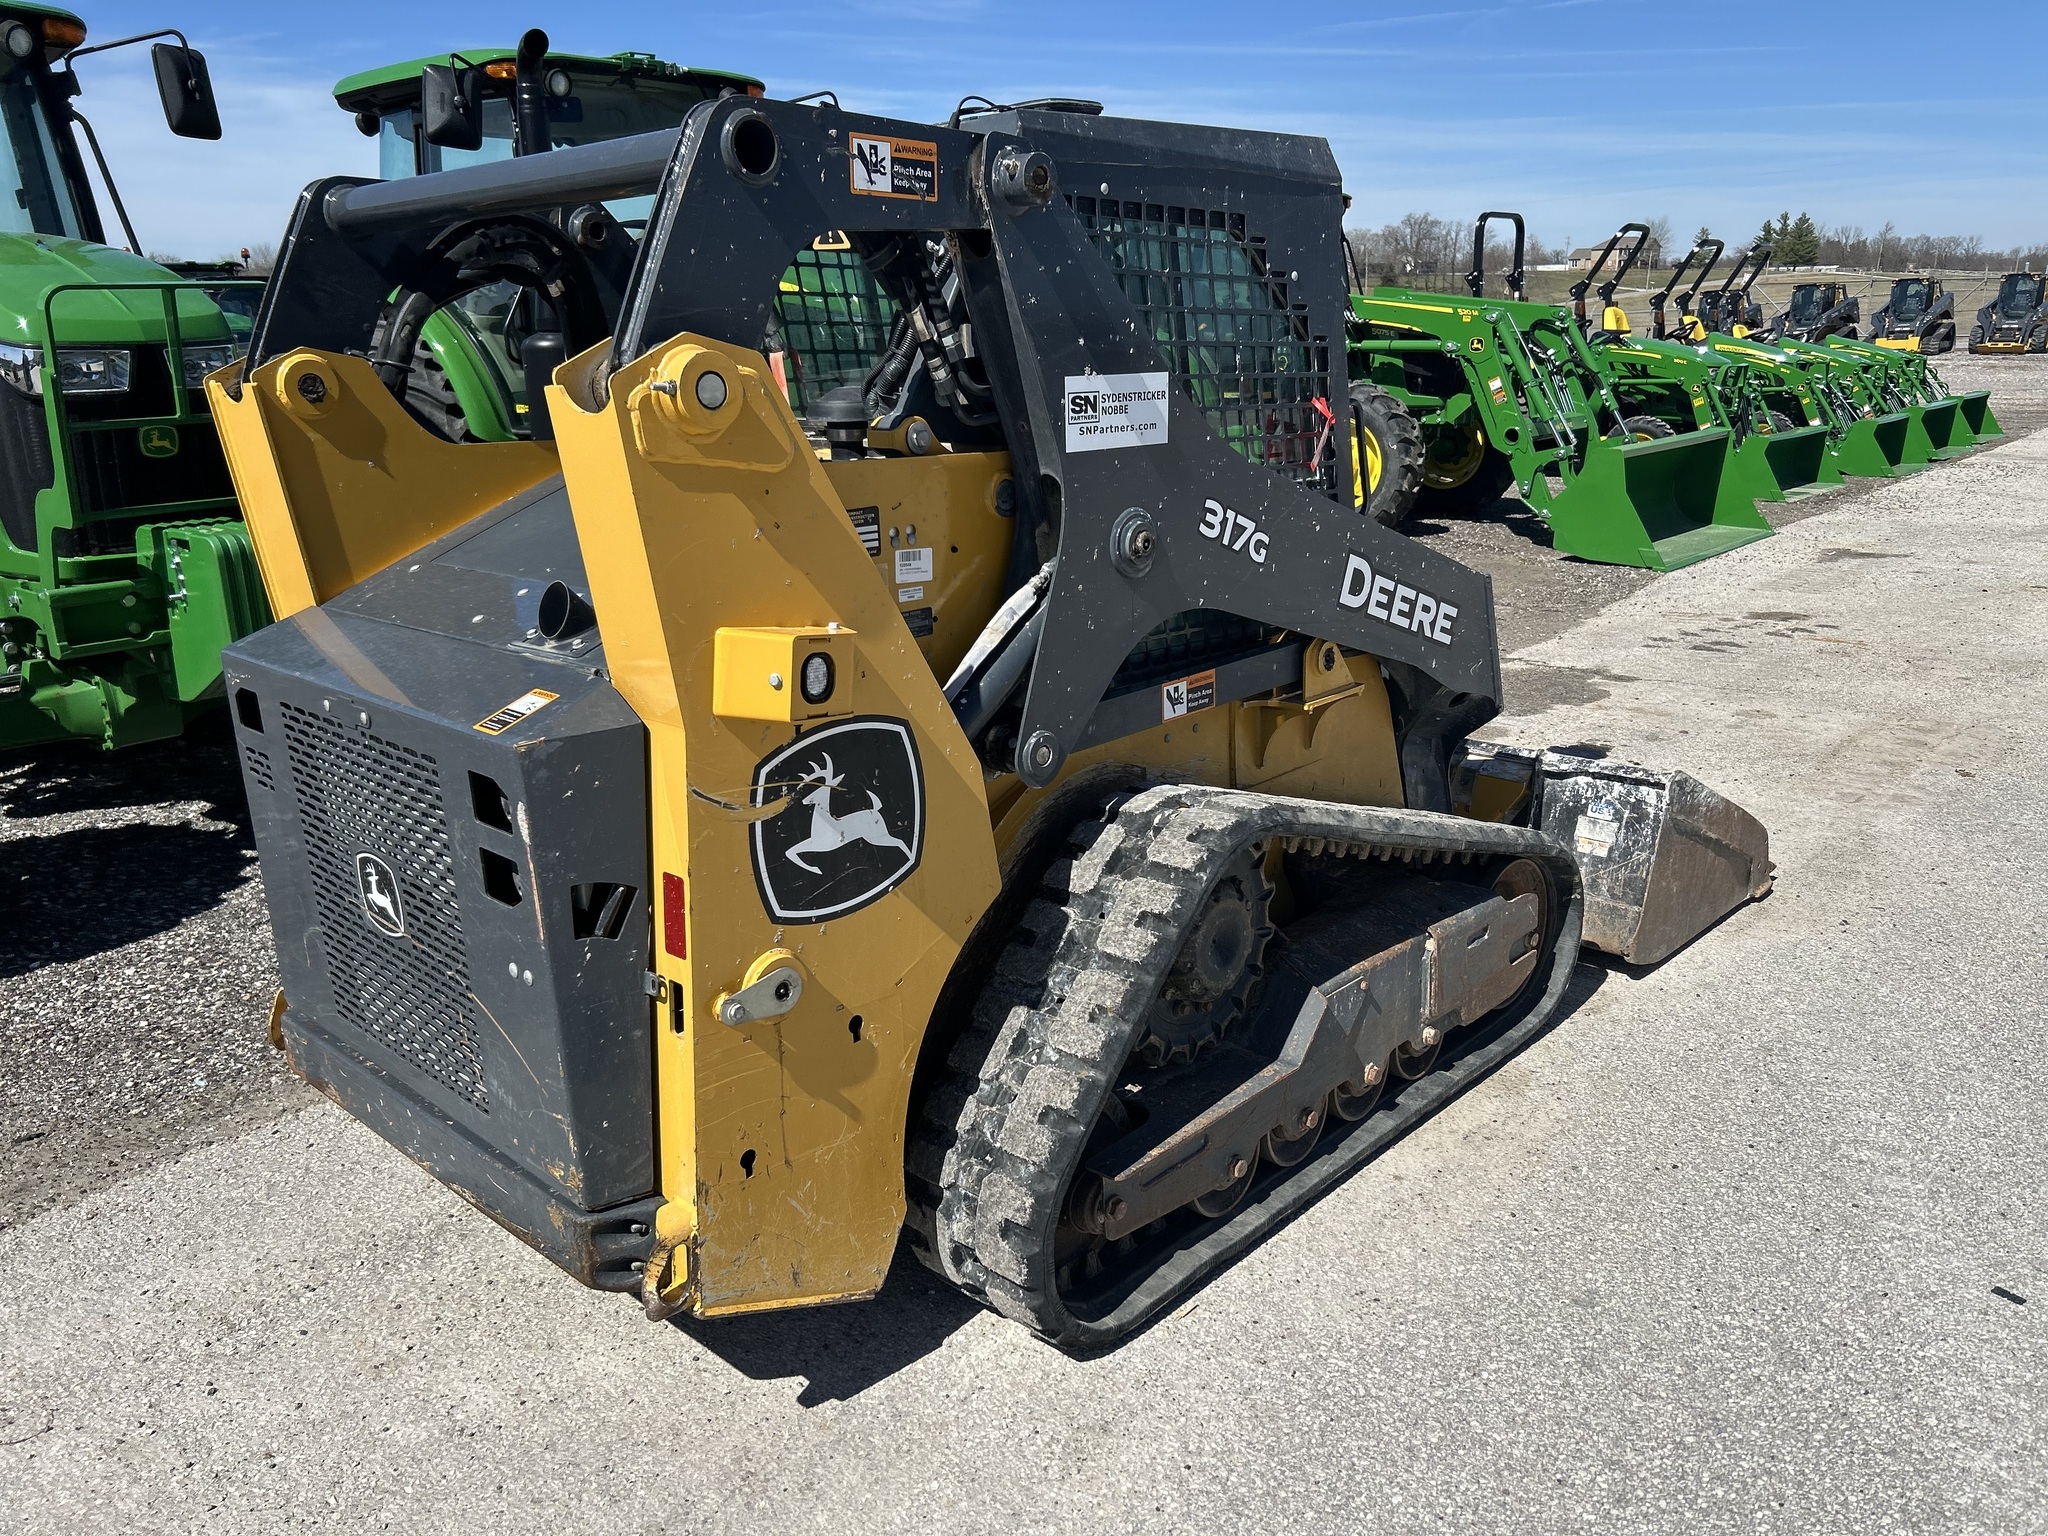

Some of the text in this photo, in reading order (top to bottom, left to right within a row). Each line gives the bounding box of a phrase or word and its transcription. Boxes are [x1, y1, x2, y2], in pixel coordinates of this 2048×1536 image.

[901, 146, 933, 156] WARNING
[894, 165, 932, 178] Pinch Area
[893, 178, 910, 188] Keep
[1457, 308, 1472, 316] 520
[1371, 327, 1390, 336] 5075
[1101, 391, 1166, 403] SYDENSTRICKER
[1070, 394, 1098, 415] SN
[1101, 404, 1129, 416] NOBBE
[1070, 414, 1098, 422] PARTNERS
[1079, 422, 1157, 435] SNPartners.com
[1199, 499, 1270, 564] 317G
[1339, 553, 1459, 645] DEERE
[1188, 691, 1201, 699] Pinch
